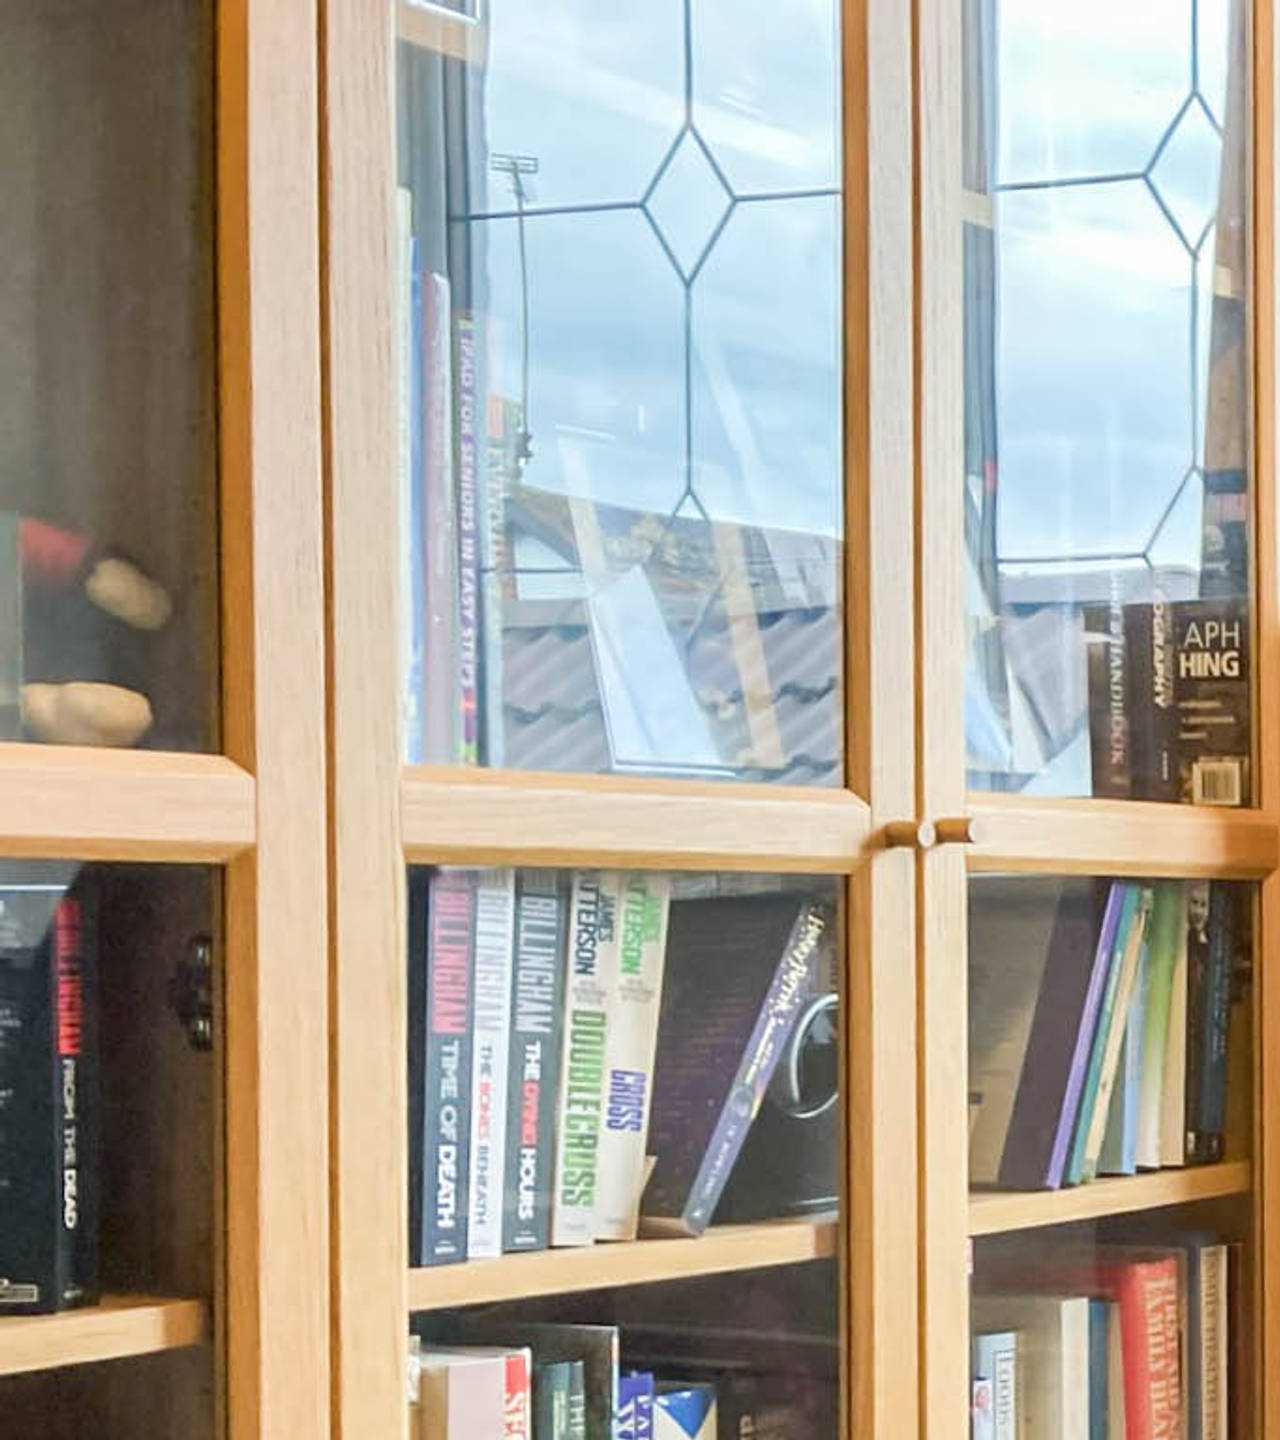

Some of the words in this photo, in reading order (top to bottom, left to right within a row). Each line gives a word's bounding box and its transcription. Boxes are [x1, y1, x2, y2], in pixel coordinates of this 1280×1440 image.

[460, 441, 476, 531] SENIORS
[460, 537, 476, 560] IN
[460, 567, 476, 620] EASY
[1184, 620, 1240, 650] APH
[1179, 651, 1240, 678] HING
[597, 892, 616, 942] JAMES
[432, 891, 469, 1034] BILLINGHAM
[516, 896, 556, 1033] BILLINGHAM
[440, 1039, 459, 1099] TIME
[480, 1045, 492, 1077] THE
[523, 1041, 542, 1080] THE
[440, 1105, 458, 1143] OF
[520, 1081, 541, 1145] DYING
[607, 1068, 647, 1132] CROSS
[64, 1126, 76, 1167] THE
[64, 1169, 77, 1230] DEAD
[436, 1145, 457, 1228] DEATH
[475, 1145, 489, 1225] BENEATH
[516, 1148, 536, 1221] HOURS
[569, 1394, 585, 1438] THE
